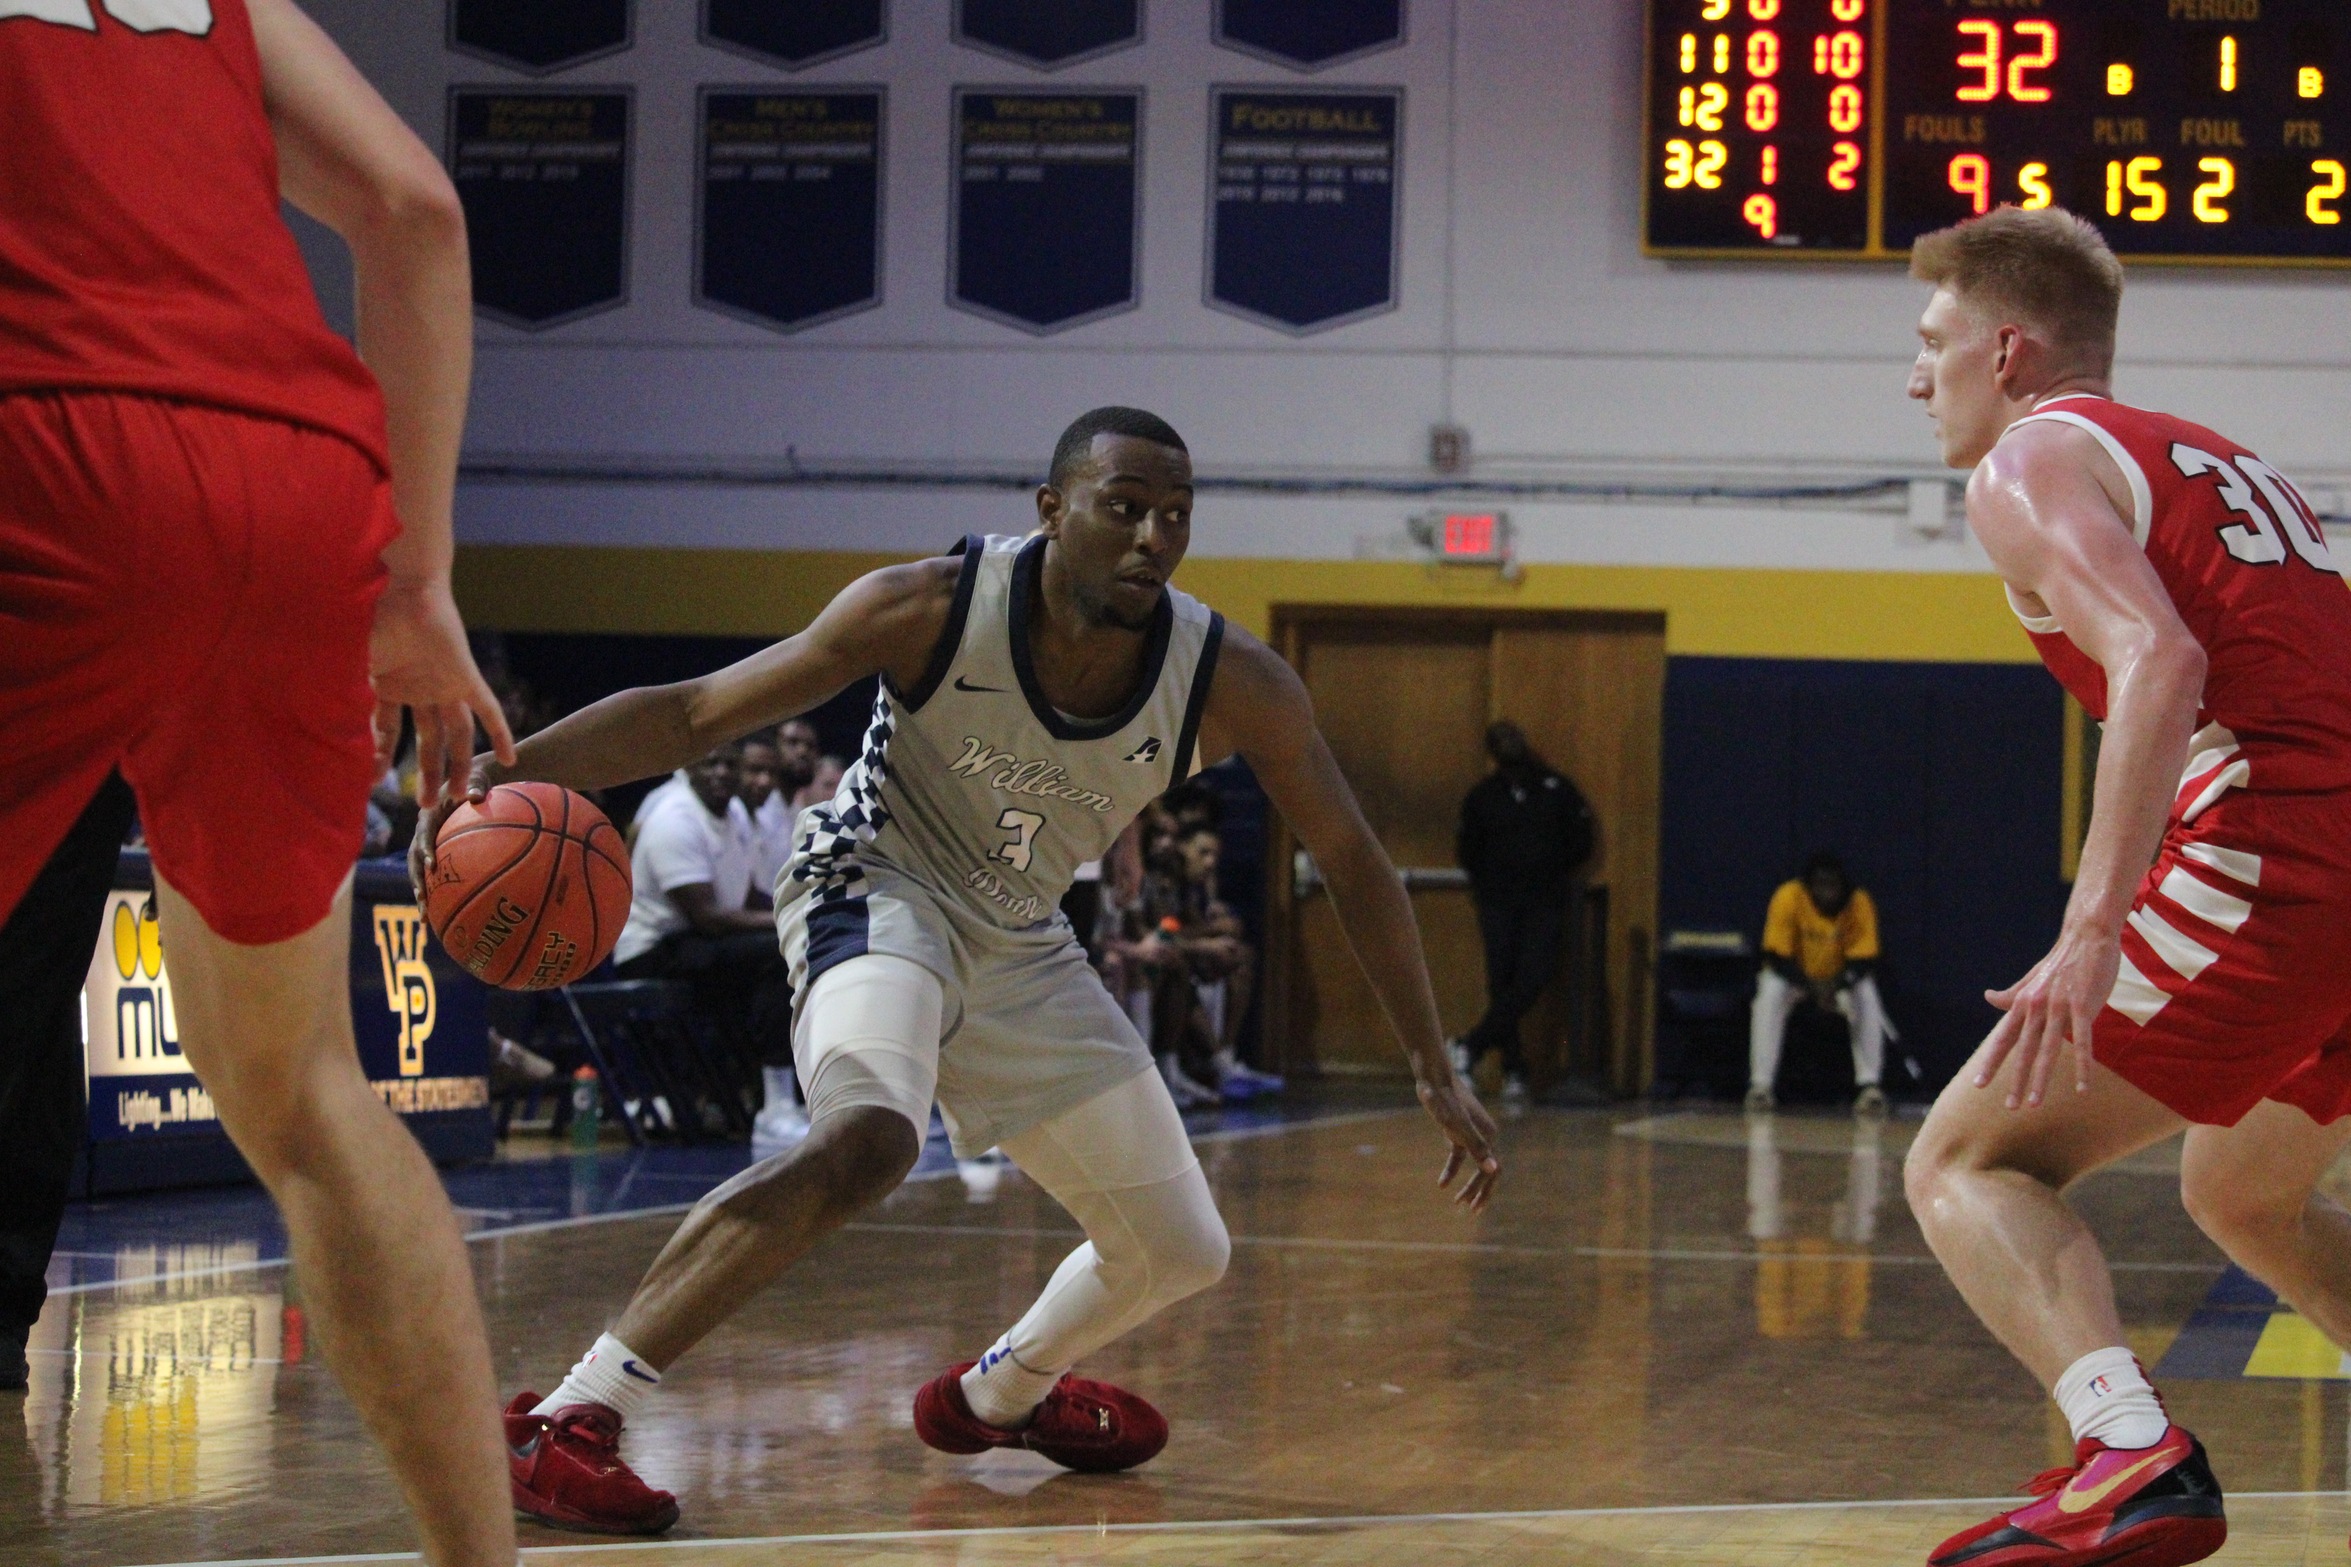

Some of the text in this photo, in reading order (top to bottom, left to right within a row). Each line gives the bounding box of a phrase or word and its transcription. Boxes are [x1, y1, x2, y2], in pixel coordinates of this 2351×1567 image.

[1680, 29, 1864, 79] 11 0 10
[1956, 19, 2058, 101] 32
[2220, 35, 2237, 92] 1
[1679, 82, 1862, 132] 12 0 0
[1905, 115, 1986, 143] FOULS
[2094, 117, 2149, 145] PLYR
[2182, 118, 2245, 147] FOUL
[2284, 120, 2322, 148] PTS
[1664, 139, 1861, 190] 32 1 2
[1948, 153, 1990, 214] 9
[2106, 156, 2167, 222] 15
[2193, 157, 2234, 223] 2
[2306, 159, 2346, 224] 2
[1743, 193, 1776, 239] 9
[949, 735, 1114, 812] William
[987, 807, 1046, 873] 3
